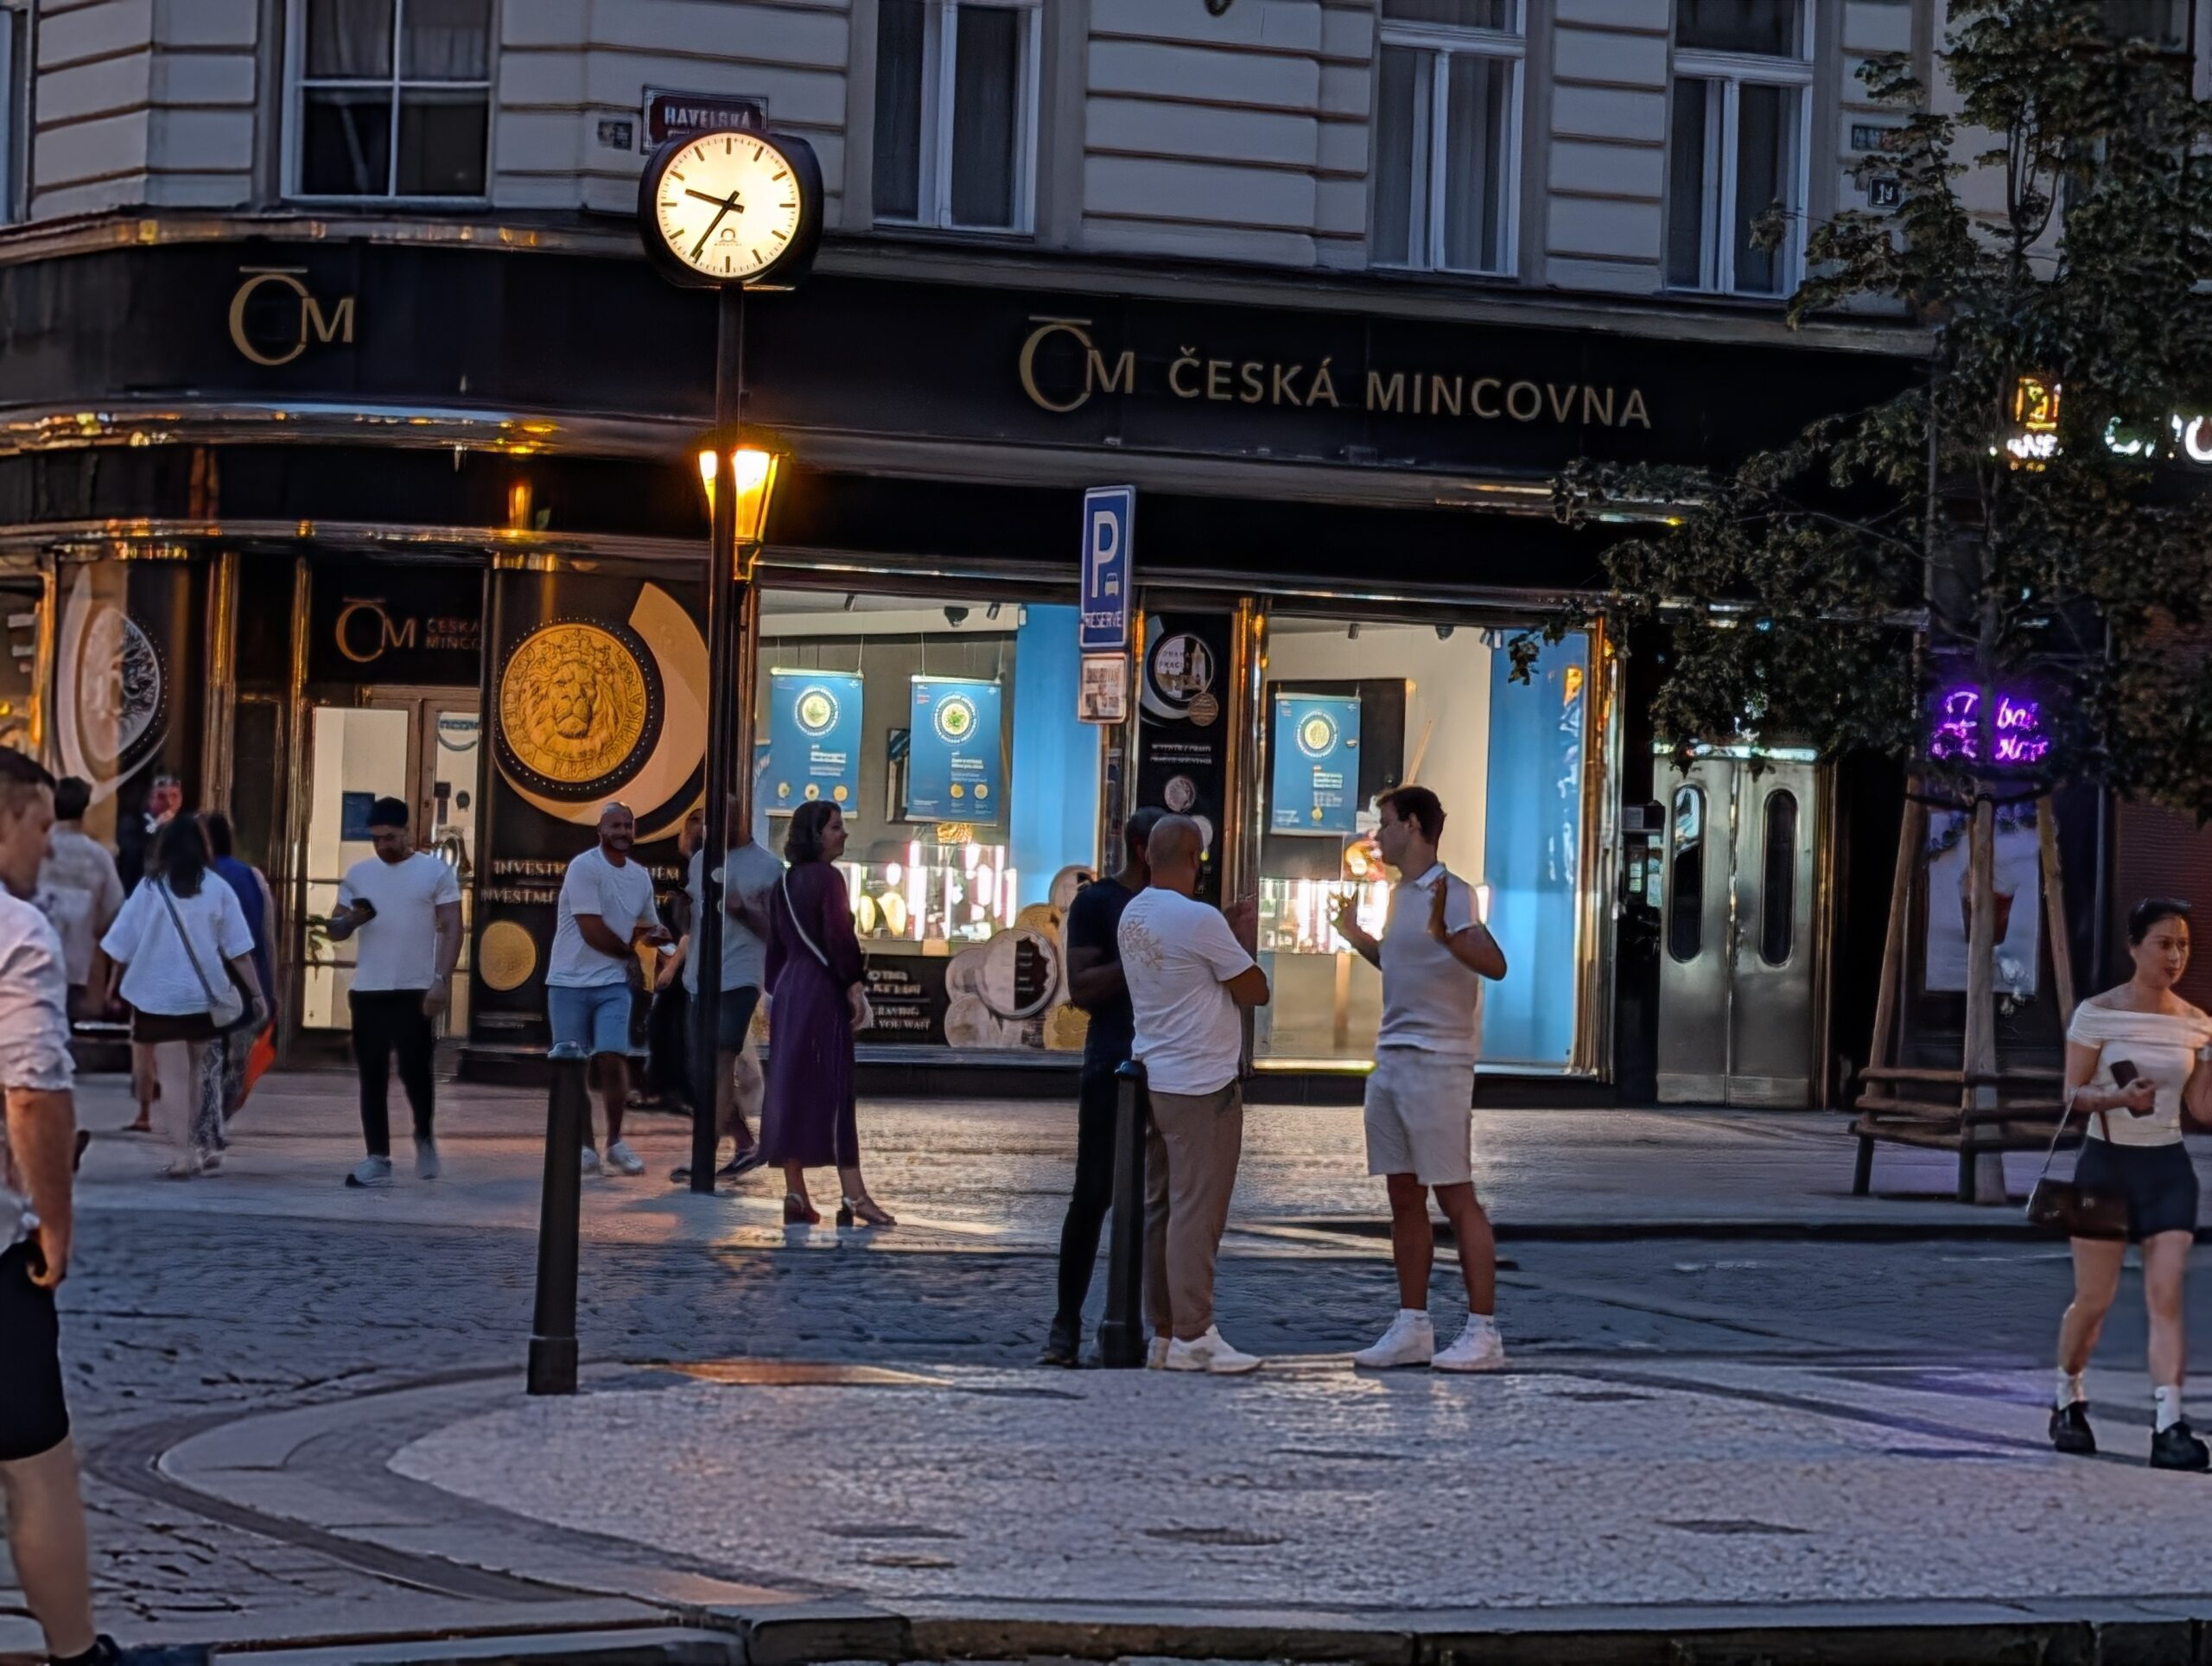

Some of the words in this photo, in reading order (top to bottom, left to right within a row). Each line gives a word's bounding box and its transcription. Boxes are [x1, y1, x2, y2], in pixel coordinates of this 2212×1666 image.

[1169, 346, 1339, 408] ČESKÁ
[1366, 371, 1652, 429] MINCOVNA
[1091, 511, 1119, 599] P
